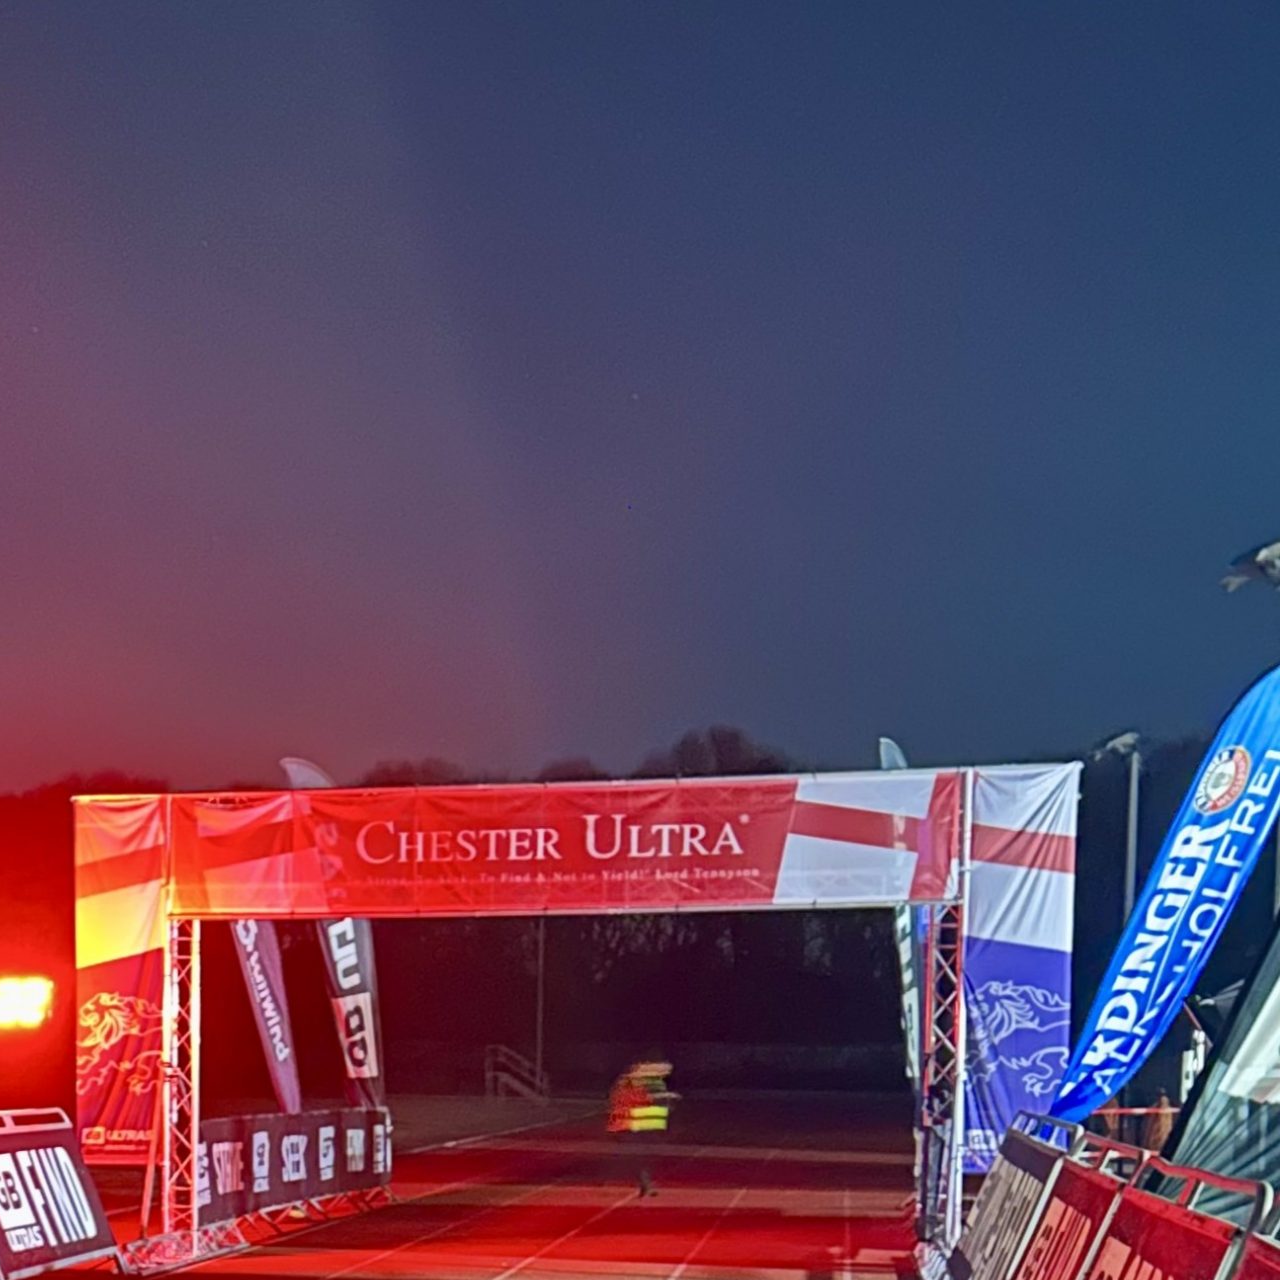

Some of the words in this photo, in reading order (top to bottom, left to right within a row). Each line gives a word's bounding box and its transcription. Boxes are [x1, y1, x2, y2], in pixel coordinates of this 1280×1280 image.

[356, 821, 562, 865] CHESTER
[583, 814, 744, 859] ULTRA
[18, 1147, 98, 1247] FIND
